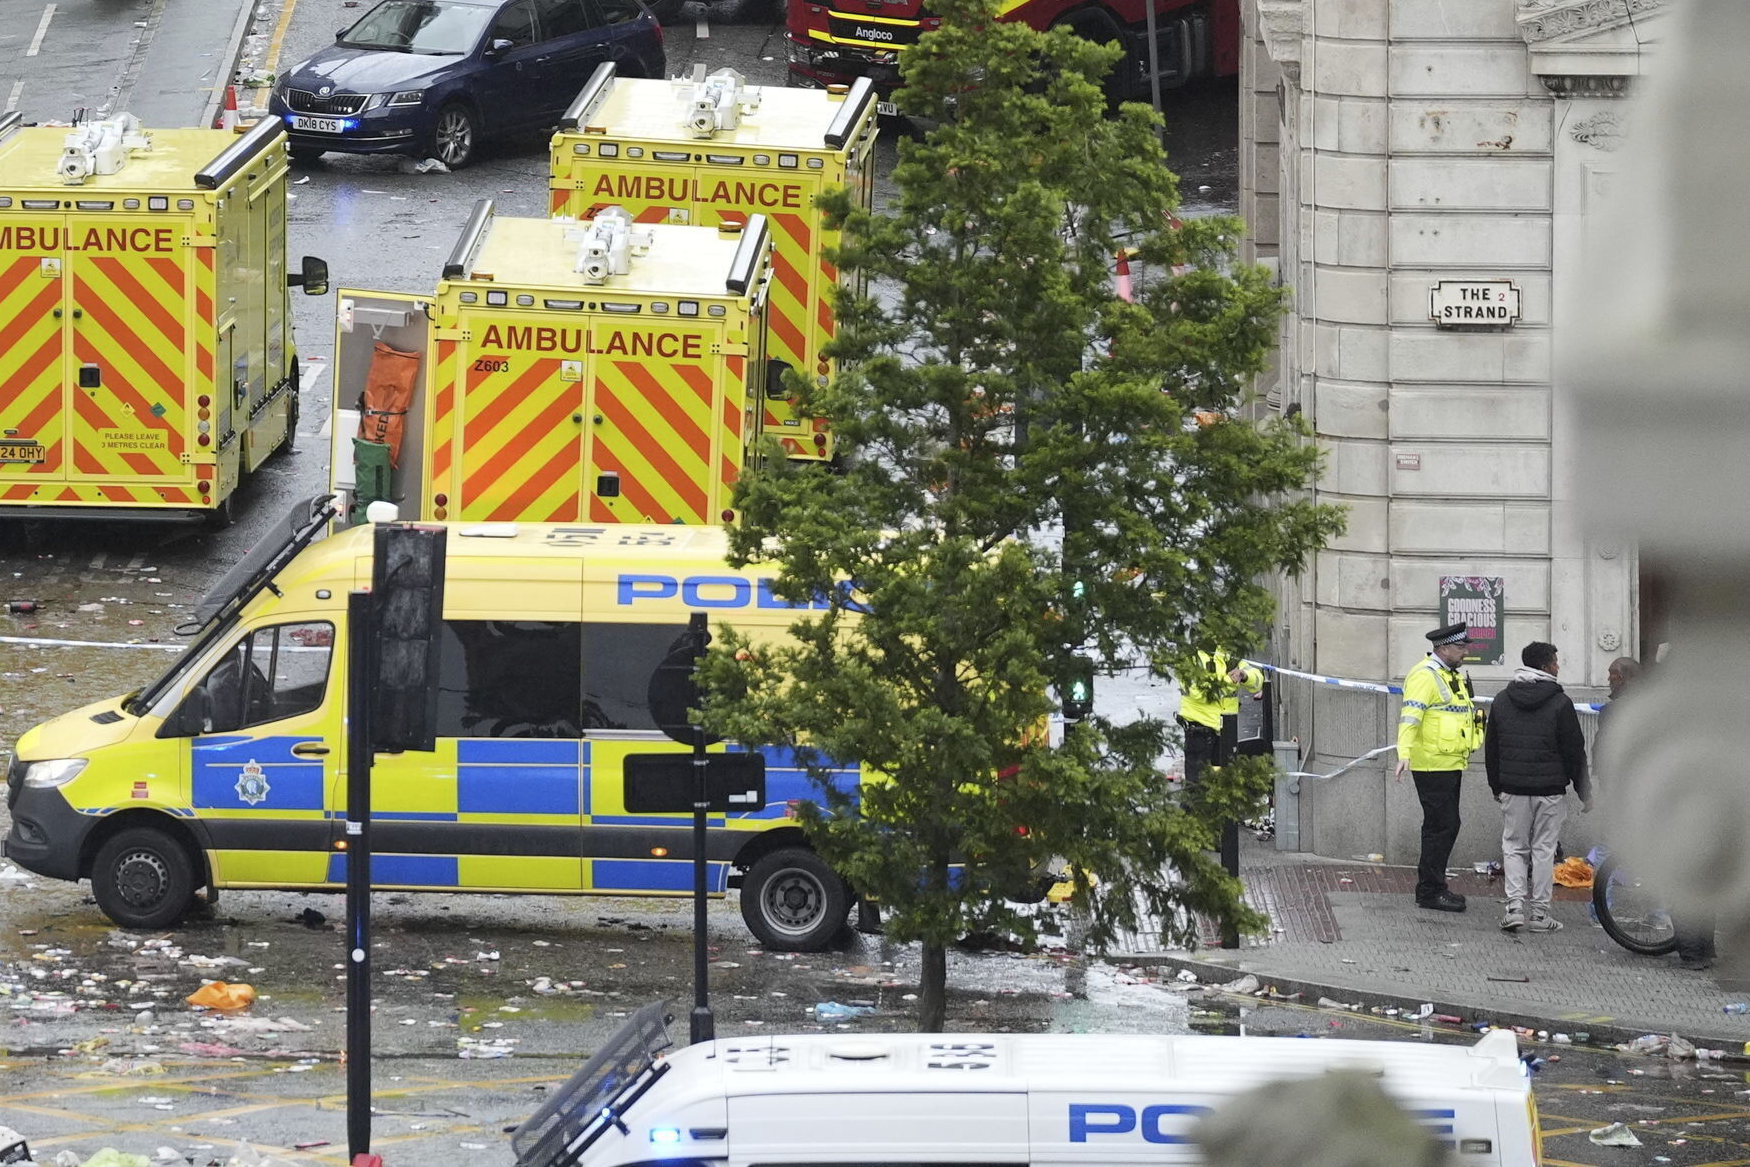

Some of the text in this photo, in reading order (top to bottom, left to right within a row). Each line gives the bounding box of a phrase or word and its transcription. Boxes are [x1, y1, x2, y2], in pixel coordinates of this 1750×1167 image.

[855, 27, 893, 40] Angloco
[298, 118, 336, 131] DK18 CYS
[593, 173, 801, 208] AMBULANCE
[1460, 288, 1505, 301] THE 2
[1444, 306, 1507, 318] STRAND
[480, 324, 702, 359] AMBULANCE
[474, 359, 509, 373] Z603
[19, 446, 43, 458] OHY
[617, 574, 875, 610] POL
[1448, 598, 1496, 613] GOODNESS
[1448, 613, 1496, 627] GRACIOUS
[1069, 1104, 1456, 1149] POE
